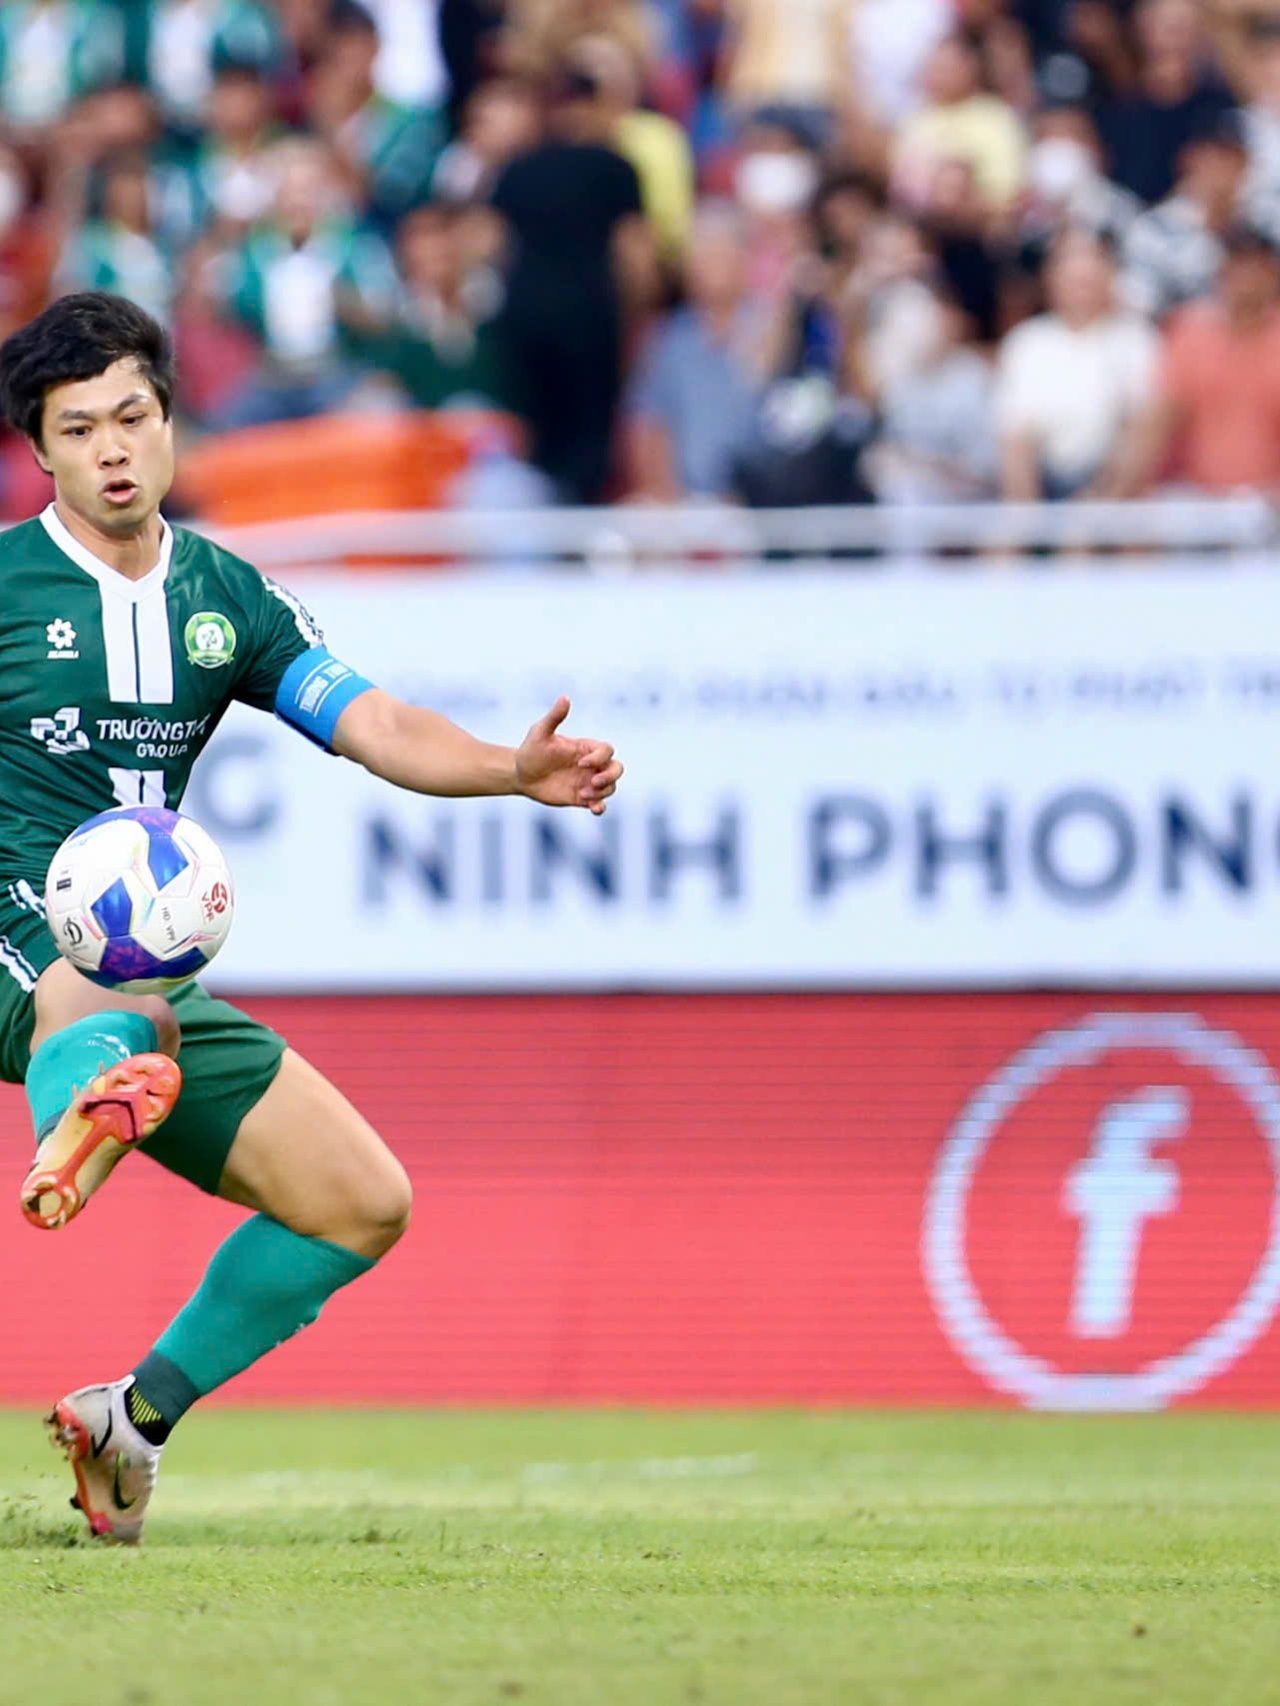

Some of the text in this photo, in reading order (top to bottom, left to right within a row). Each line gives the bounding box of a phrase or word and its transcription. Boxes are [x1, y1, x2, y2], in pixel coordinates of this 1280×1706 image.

[136, 742, 189, 759] GROUP
[362, 788, 1280, 906] NINH PHON
